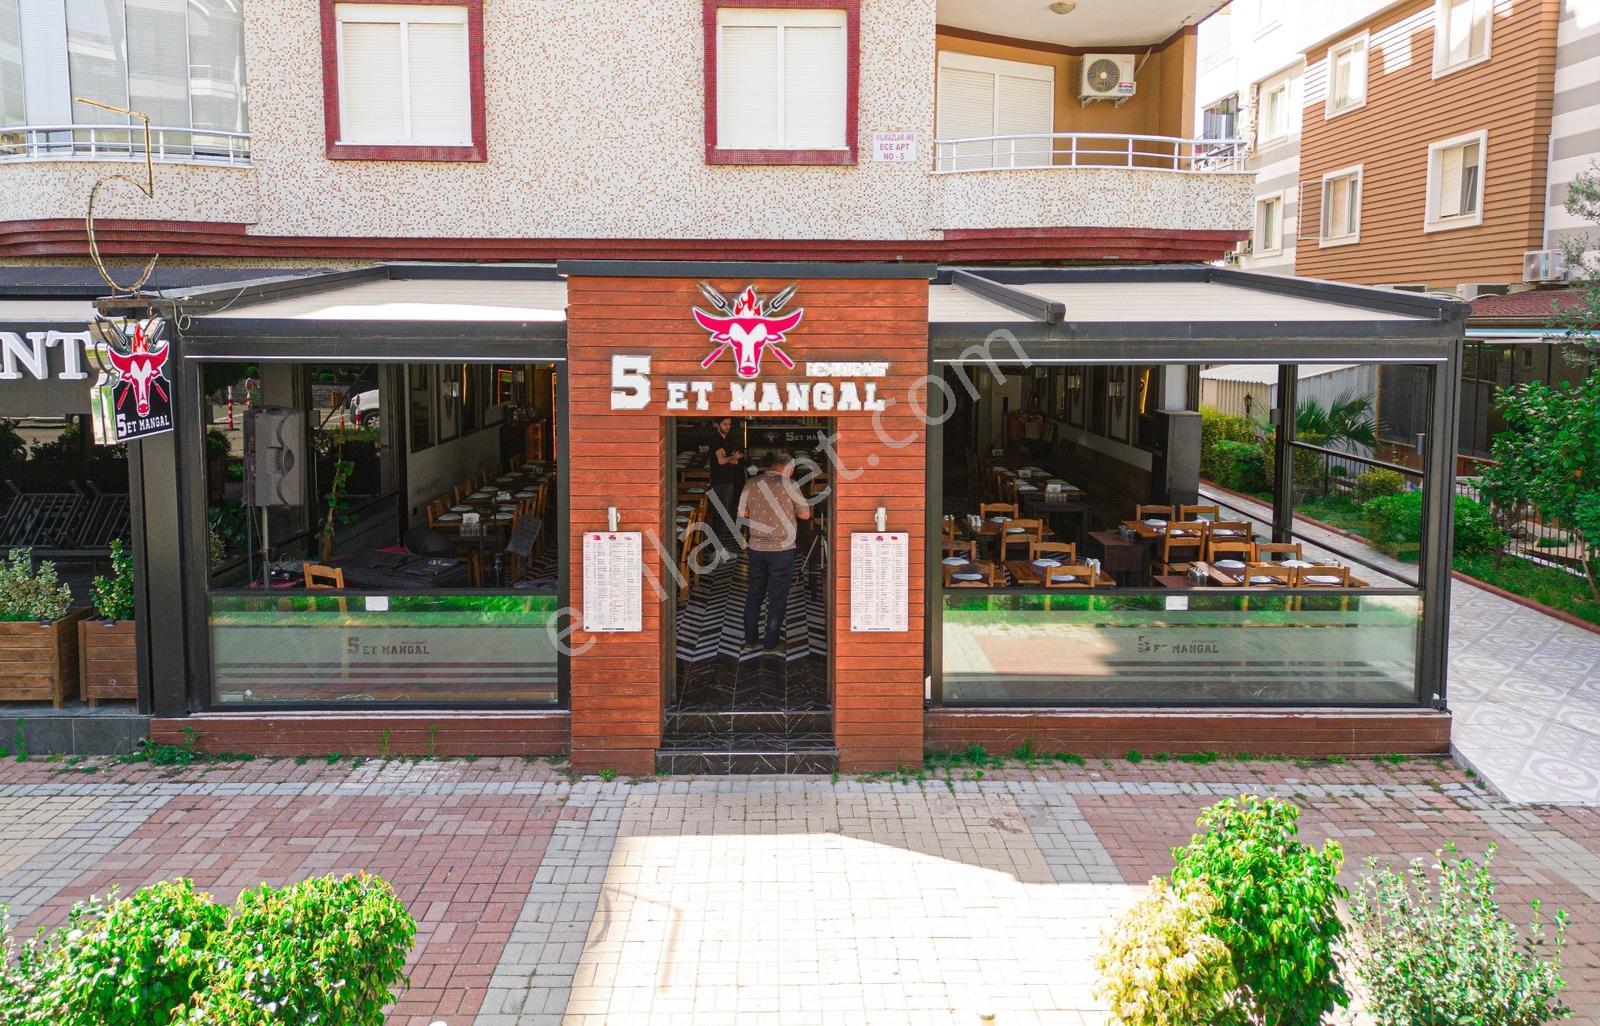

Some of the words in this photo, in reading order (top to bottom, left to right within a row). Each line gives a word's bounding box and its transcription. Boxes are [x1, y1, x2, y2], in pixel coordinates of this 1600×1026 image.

[880, 143, 894, 151] ECE
[896, 143, 910, 151] APT
[883, 152, 894, 160] NO
[0, 330, 92, 380] NT
[611, 355, 651, 410] 5
[667, 381, 714, 411] ET
[730, 381, 886, 411] MANGAL
[139, 415, 170, 431] MANGAL
[362, 645, 378, 655] ET
[382, 645, 430, 655] MANGAL
[1172, 644, 1219, 654] MANGAL
